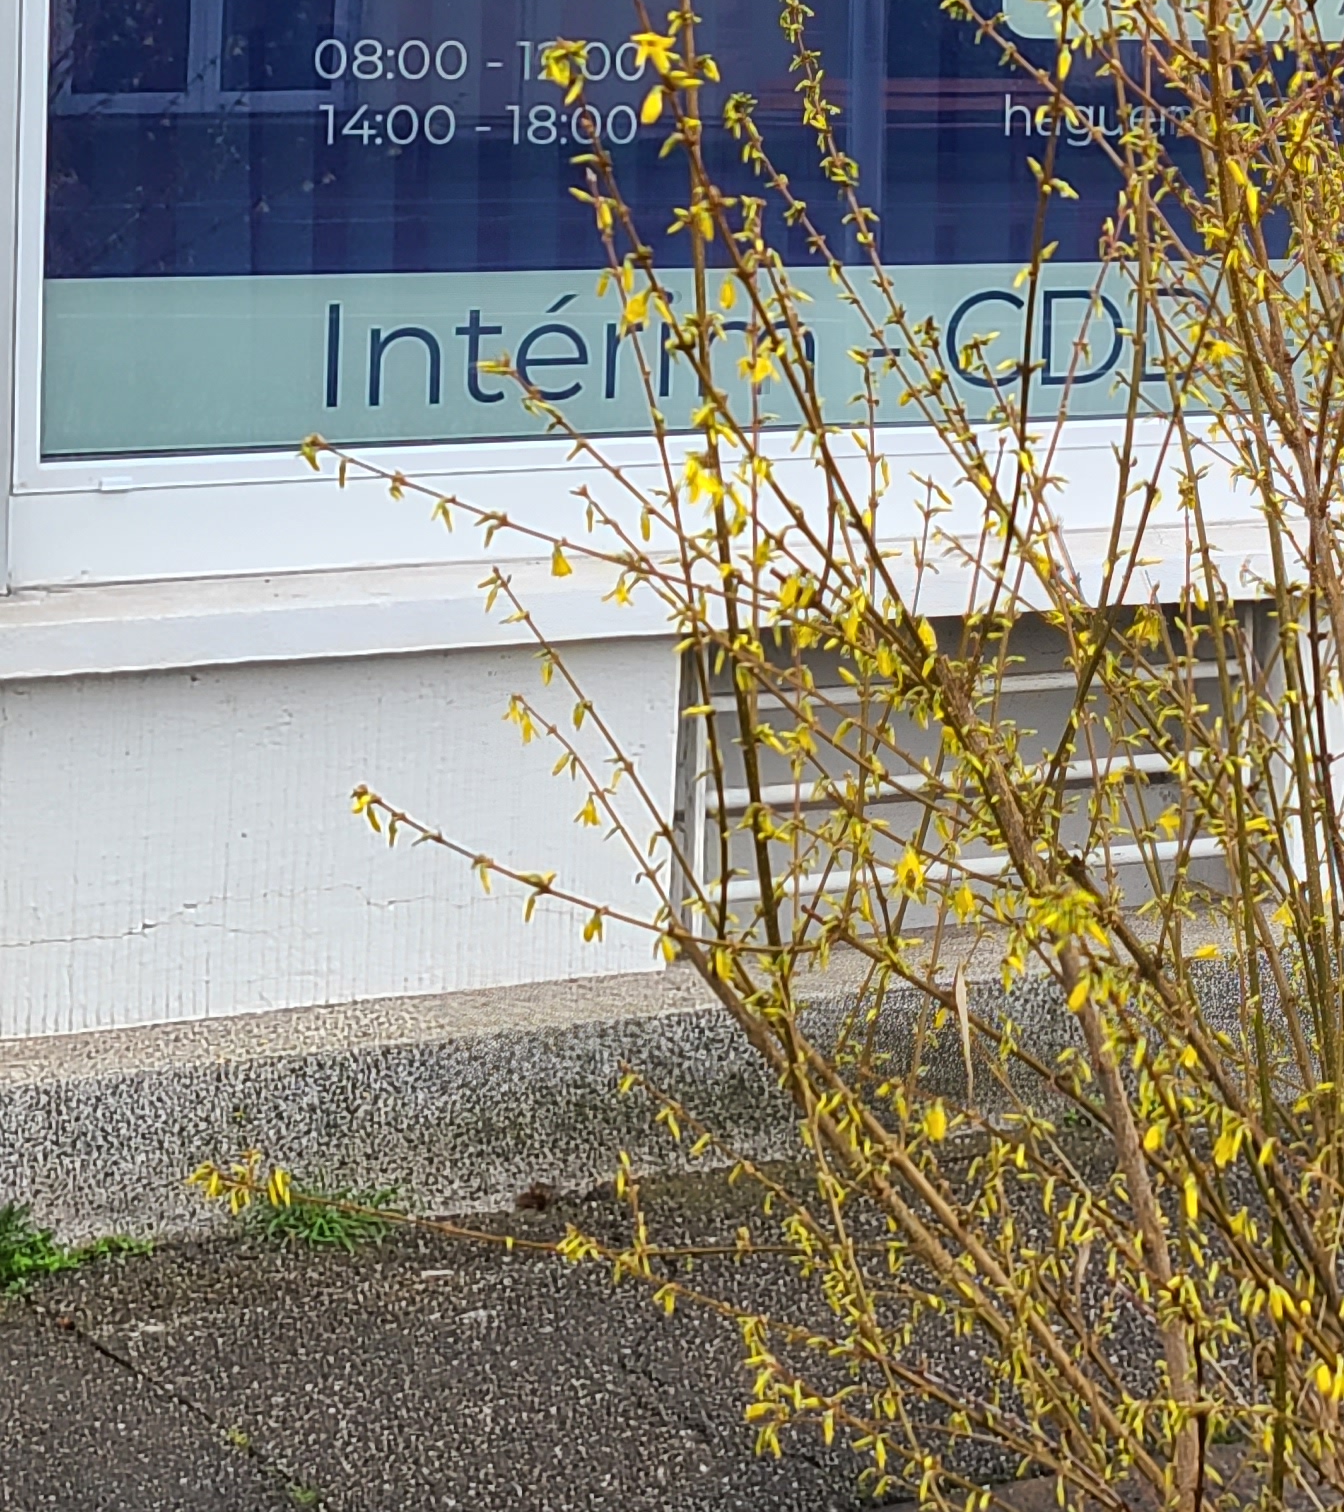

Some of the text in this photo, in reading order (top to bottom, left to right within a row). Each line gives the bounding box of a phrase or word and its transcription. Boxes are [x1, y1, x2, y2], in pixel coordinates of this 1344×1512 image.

[313, 38, 468, 81] 08:00
[318, 103, 456, 146] 14:00
[505, 104, 638, 146] 18:00
